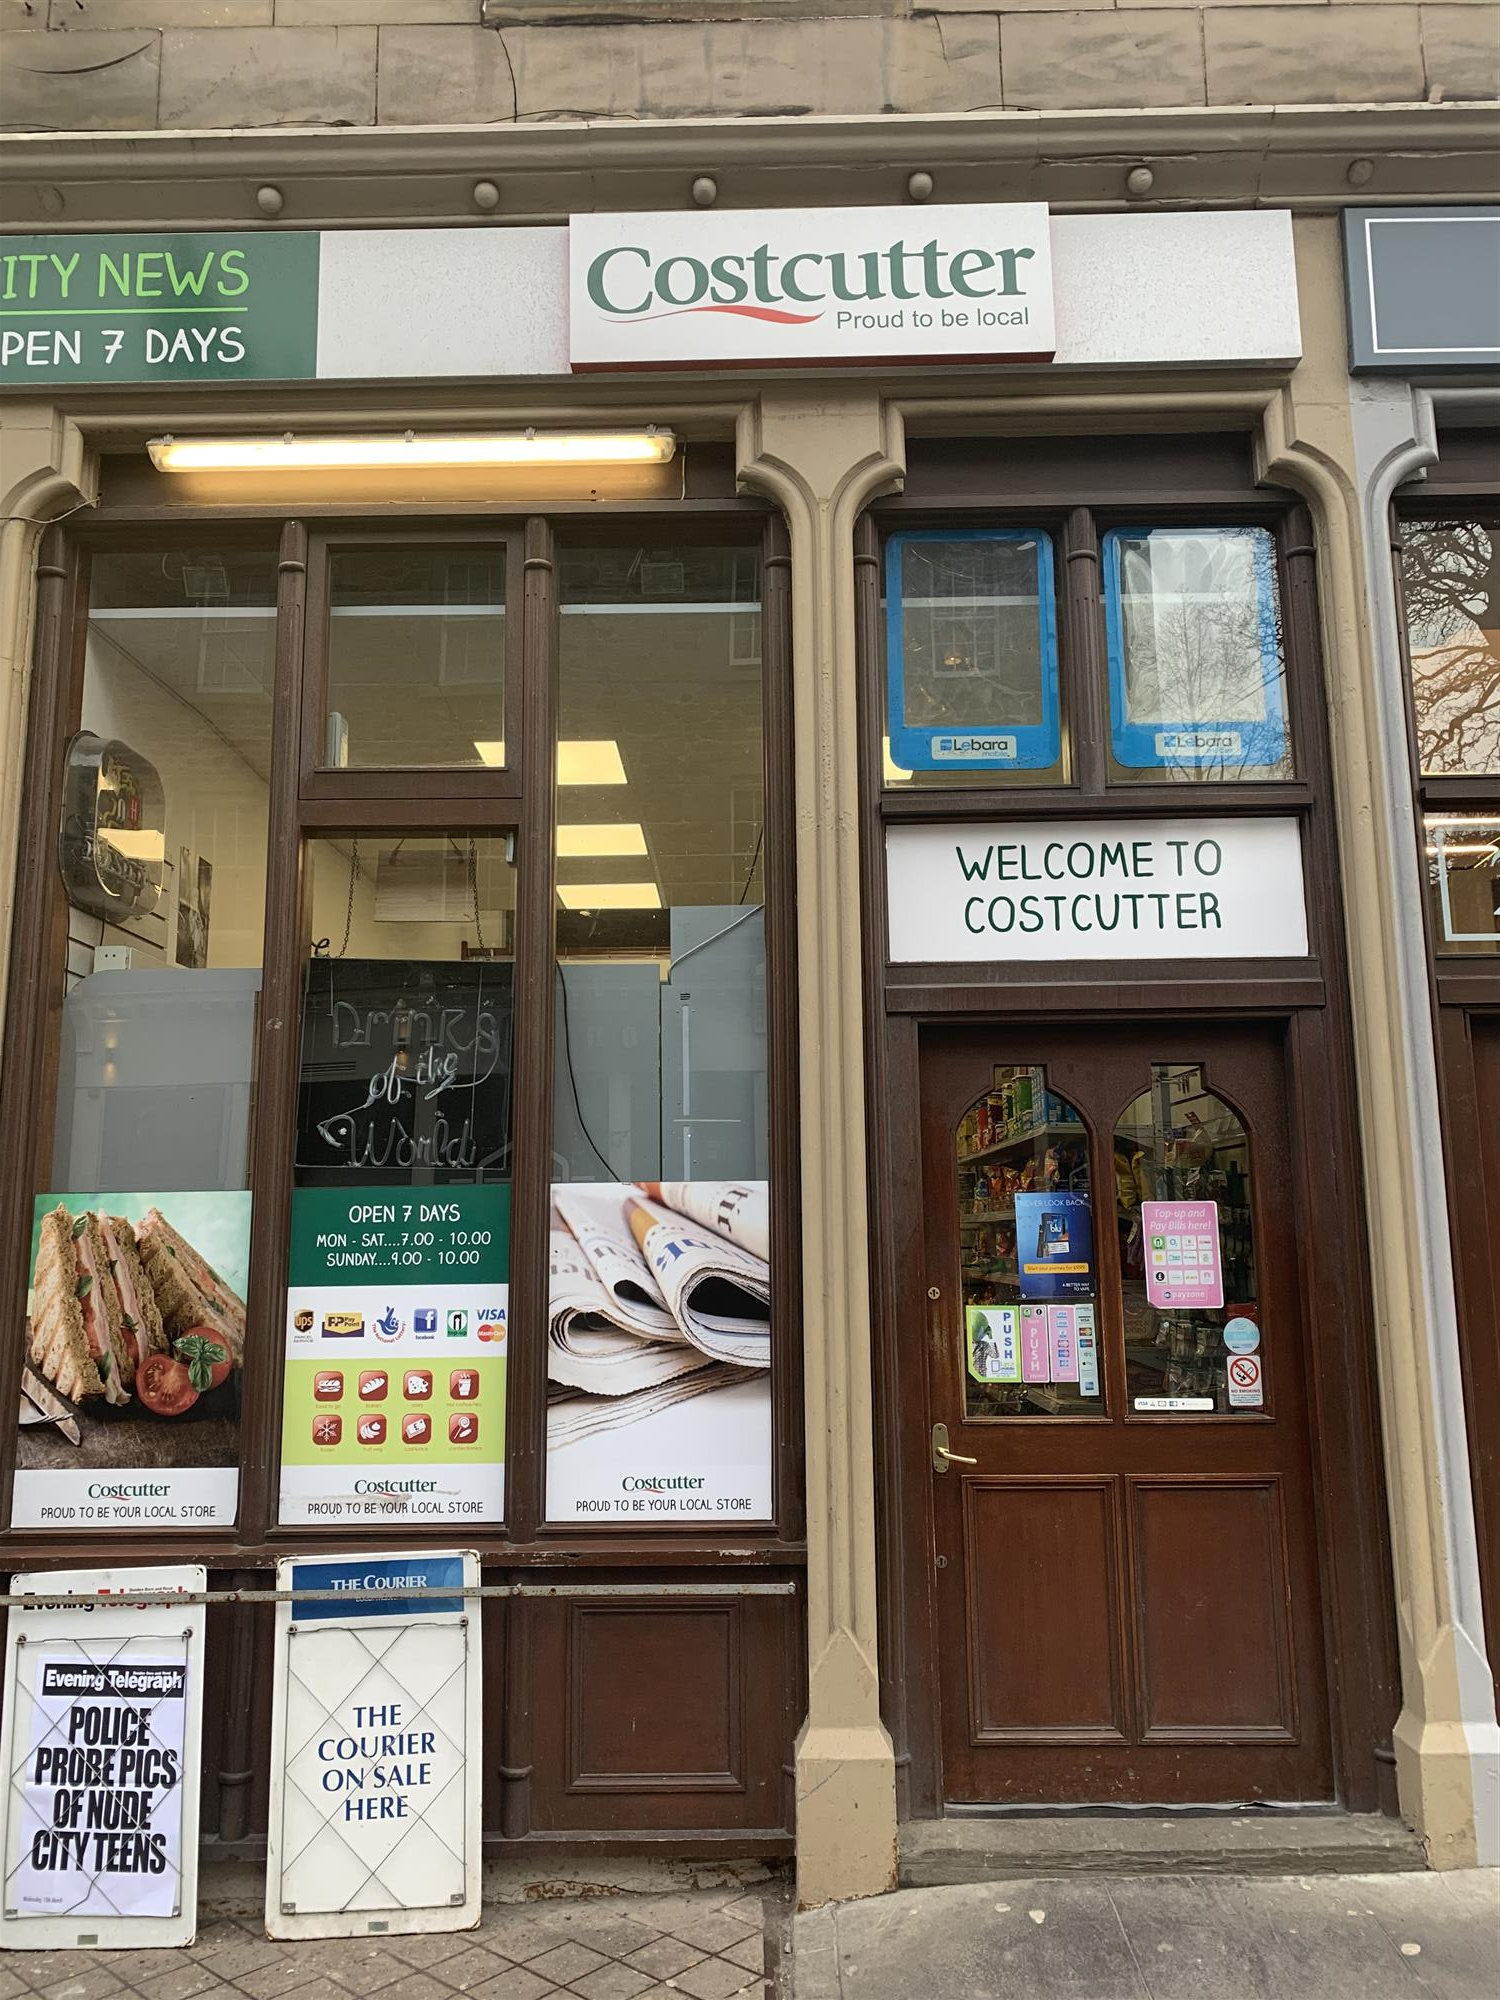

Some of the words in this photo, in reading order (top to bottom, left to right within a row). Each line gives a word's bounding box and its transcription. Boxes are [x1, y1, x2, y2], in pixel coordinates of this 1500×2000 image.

[0, 253, 80, 299] ITY
[99, 249, 250, 298] NEWS
[587, 239, 1036, 314] Costcutter
[836, 310, 904, 330] Proud
[912, 310, 933, 328] to
[941, 308, 969, 327] be
[977, 307, 1030, 326] local
[101, 329, 125, 364] 7
[146, 326, 245, 365] DAYS
[953, 738, 1008, 751] Lebara
[1177, 735, 1232, 748] Lebara
[956, 841, 1154, 881] WELCOME
[1166, 839, 1222, 877] TO
[964, 892, 1222, 934] COSTCUTTER
[416, 1046, 458, 1086] the
[348, 1205, 395, 1223] OPEN
[402, 1205, 412, 1222] 7
[420, 1204, 461, 1222] DAYS
[1020, 1199, 1044, 1207] EVER
[1044, 1199, 1065, 1207] LOOK
[1155, 1208, 1186, 1219] Top-up
[1187, 1208, 1205, 1218] and
[1150, 1221, 1167, 1232] Pay
[1168, 1221, 1187, 1230] Bills
[316, 1233, 347, 1248] MON
[450, 1231, 492, 1246] 10.00
[438, 1250, 480, 1265] 10.00
[296, 1316, 313, 1330] ups
[477, 1308, 506, 1321] VISA
[1003, 1312, 1013, 1360] PUSH
[1030, 1328, 1041, 1371] PUSH
[88, 1483, 171, 1499] Costcutter
[354, 1479, 438, 1494] Costcutter
[622, 1476, 705, 1491] Costcutter
[41, 1507, 76, 1519] PROUD
[78, 1506, 94, 1518] TO
[97, 1506, 110, 1518] BE
[113, 1506, 141, 1518] YOUR
[144, 1505, 177, 1518] LOCAL
[180, 1505, 216, 1517] STORE
[308, 1503, 342, 1514] PROUD
[346, 1503, 361, 1514] TO
[364, 1503, 377, 1514] BE
[379, 1502, 408, 1514] YOUR
[411, 1502, 444, 1514] LOCAL
[447, 1501, 483, 1513] STORE
[576, 1500, 611, 1512] PROUD
[614, 1500, 630, 1511] TO
[633, 1500, 645, 1511] BE
[648, 1499, 676, 1511] YOUR
[680, 1499, 712, 1511] LOCAL
[716, 1498, 752, 1510] STORE
[331, 1578, 361, 1591] THE
[363, 1574, 427, 1590] COURIER
[45, 1669, 105, 1690] Evening
[108, 1670, 182, 1693] Telegraph
[68, 1706, 151, 1747] POLICE
[353, 1704, 401, 1728] THE
[318, 1732, 436, 1761] COURIER
[35, 1747, 116, 1787] PROBE
[119, 1748, 178, 1789] PICS
[322, 1767, 364, 1792] ON
[373, 1763, 431, 1789] SALE
[53, 1788, 84, 1829] OF
[87, 1790, 153, 1830] NUDE
[345, 1795, 408, 1821] HERE
[31, 1830, 90, 1871] CITY
[93, 1832, 167, 1874] TEENS
